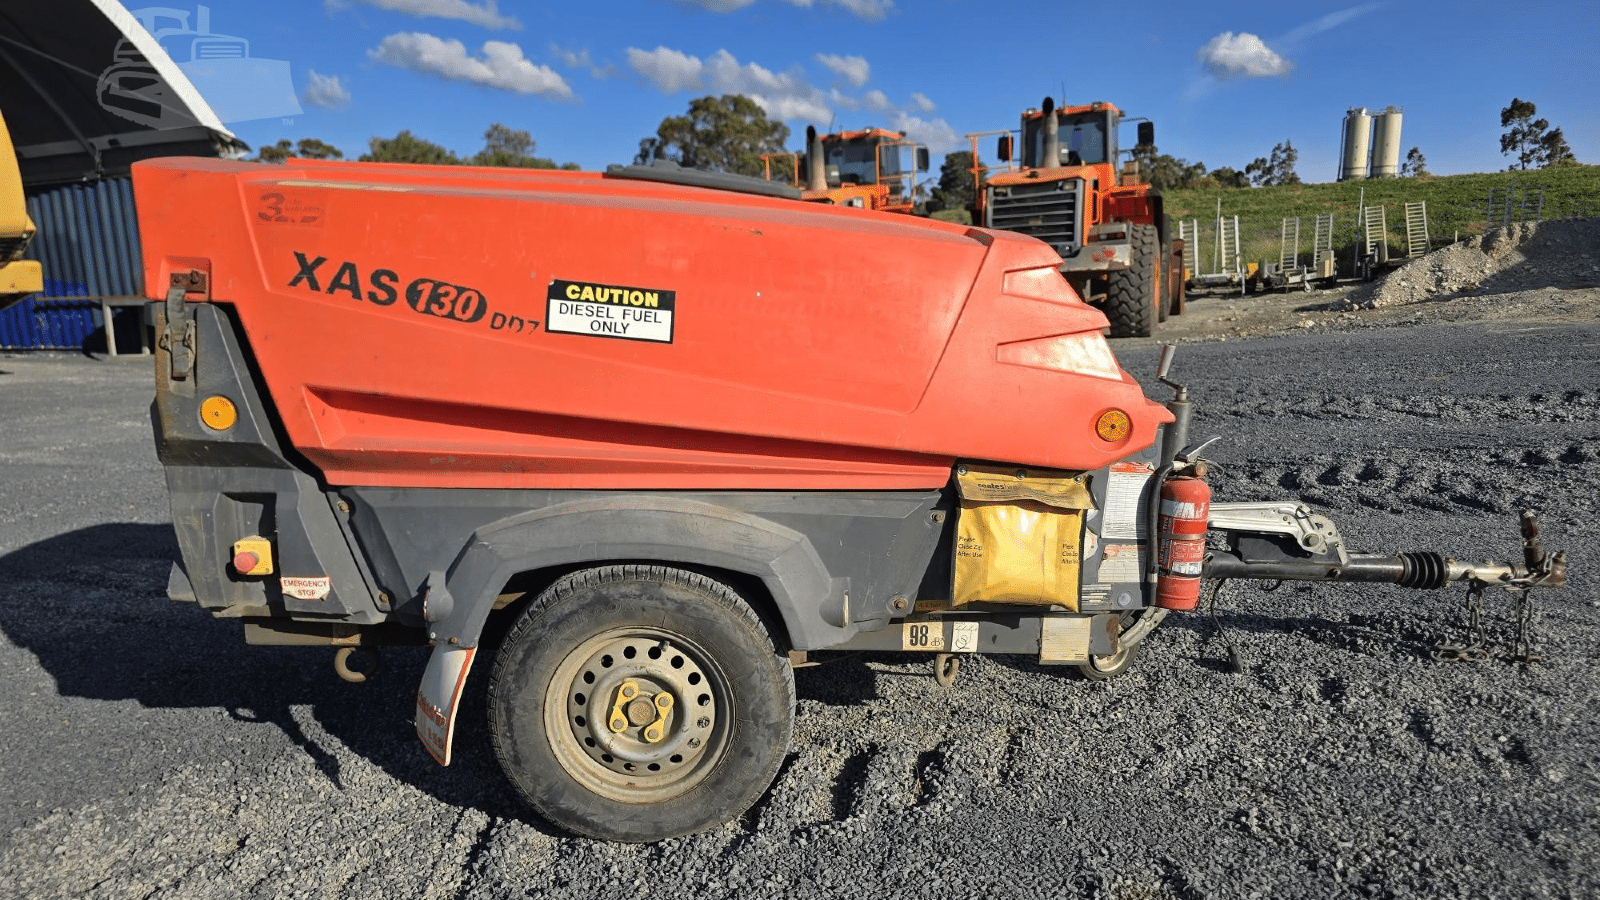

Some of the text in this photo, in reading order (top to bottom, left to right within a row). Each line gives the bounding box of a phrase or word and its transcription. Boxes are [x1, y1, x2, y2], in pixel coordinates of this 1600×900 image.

[287, 251, 399, 306] XAS
[415, 281, 480, 321] 130
[565, 284, 659, 308] CAUTION
[559, 302, 662, 324] DIESEL FUEL
[590, 319, 630, 335] ONLY
[283, 579, 327, 588] EMERGENCY
[909, 624, 929, 647] 98
